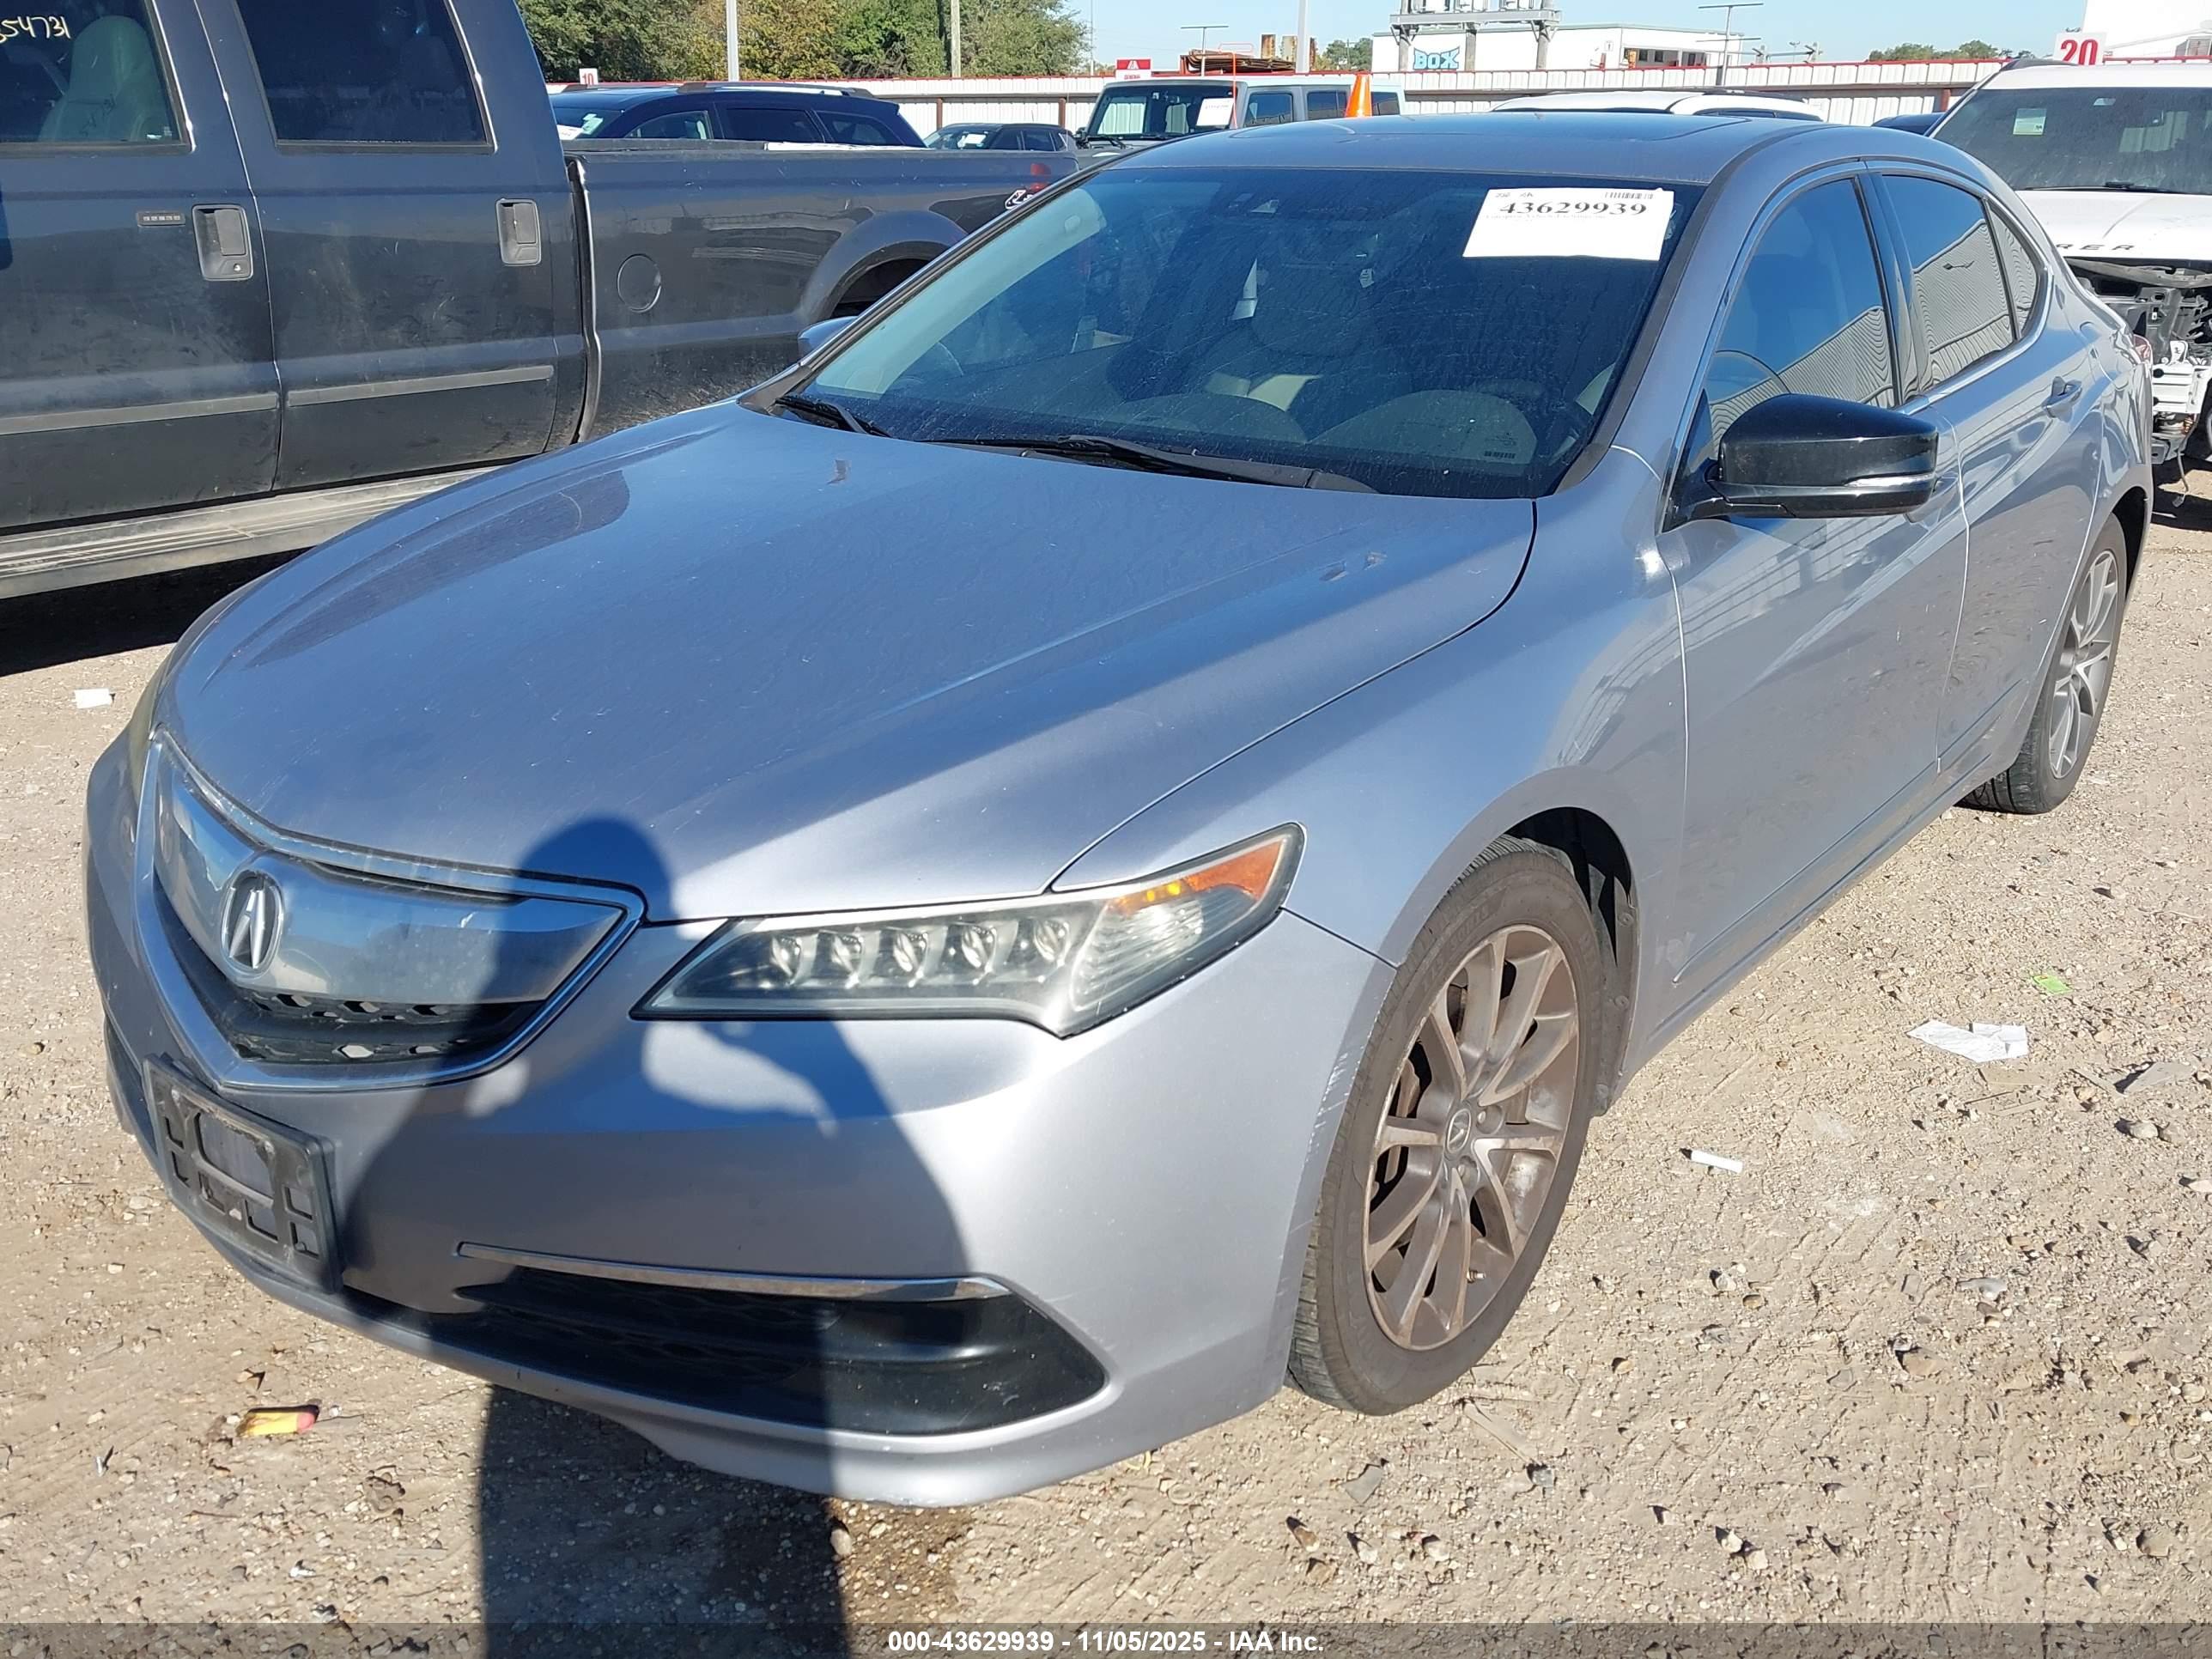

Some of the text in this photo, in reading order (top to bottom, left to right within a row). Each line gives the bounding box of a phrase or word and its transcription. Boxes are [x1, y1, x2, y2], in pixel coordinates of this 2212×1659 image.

[1413, 46, 1461, 70] BOX
[2060, 39, 2099, 65] 20
[582, 72, 594, 85] 10
[1499, 201, 1647, 216] 43629939
